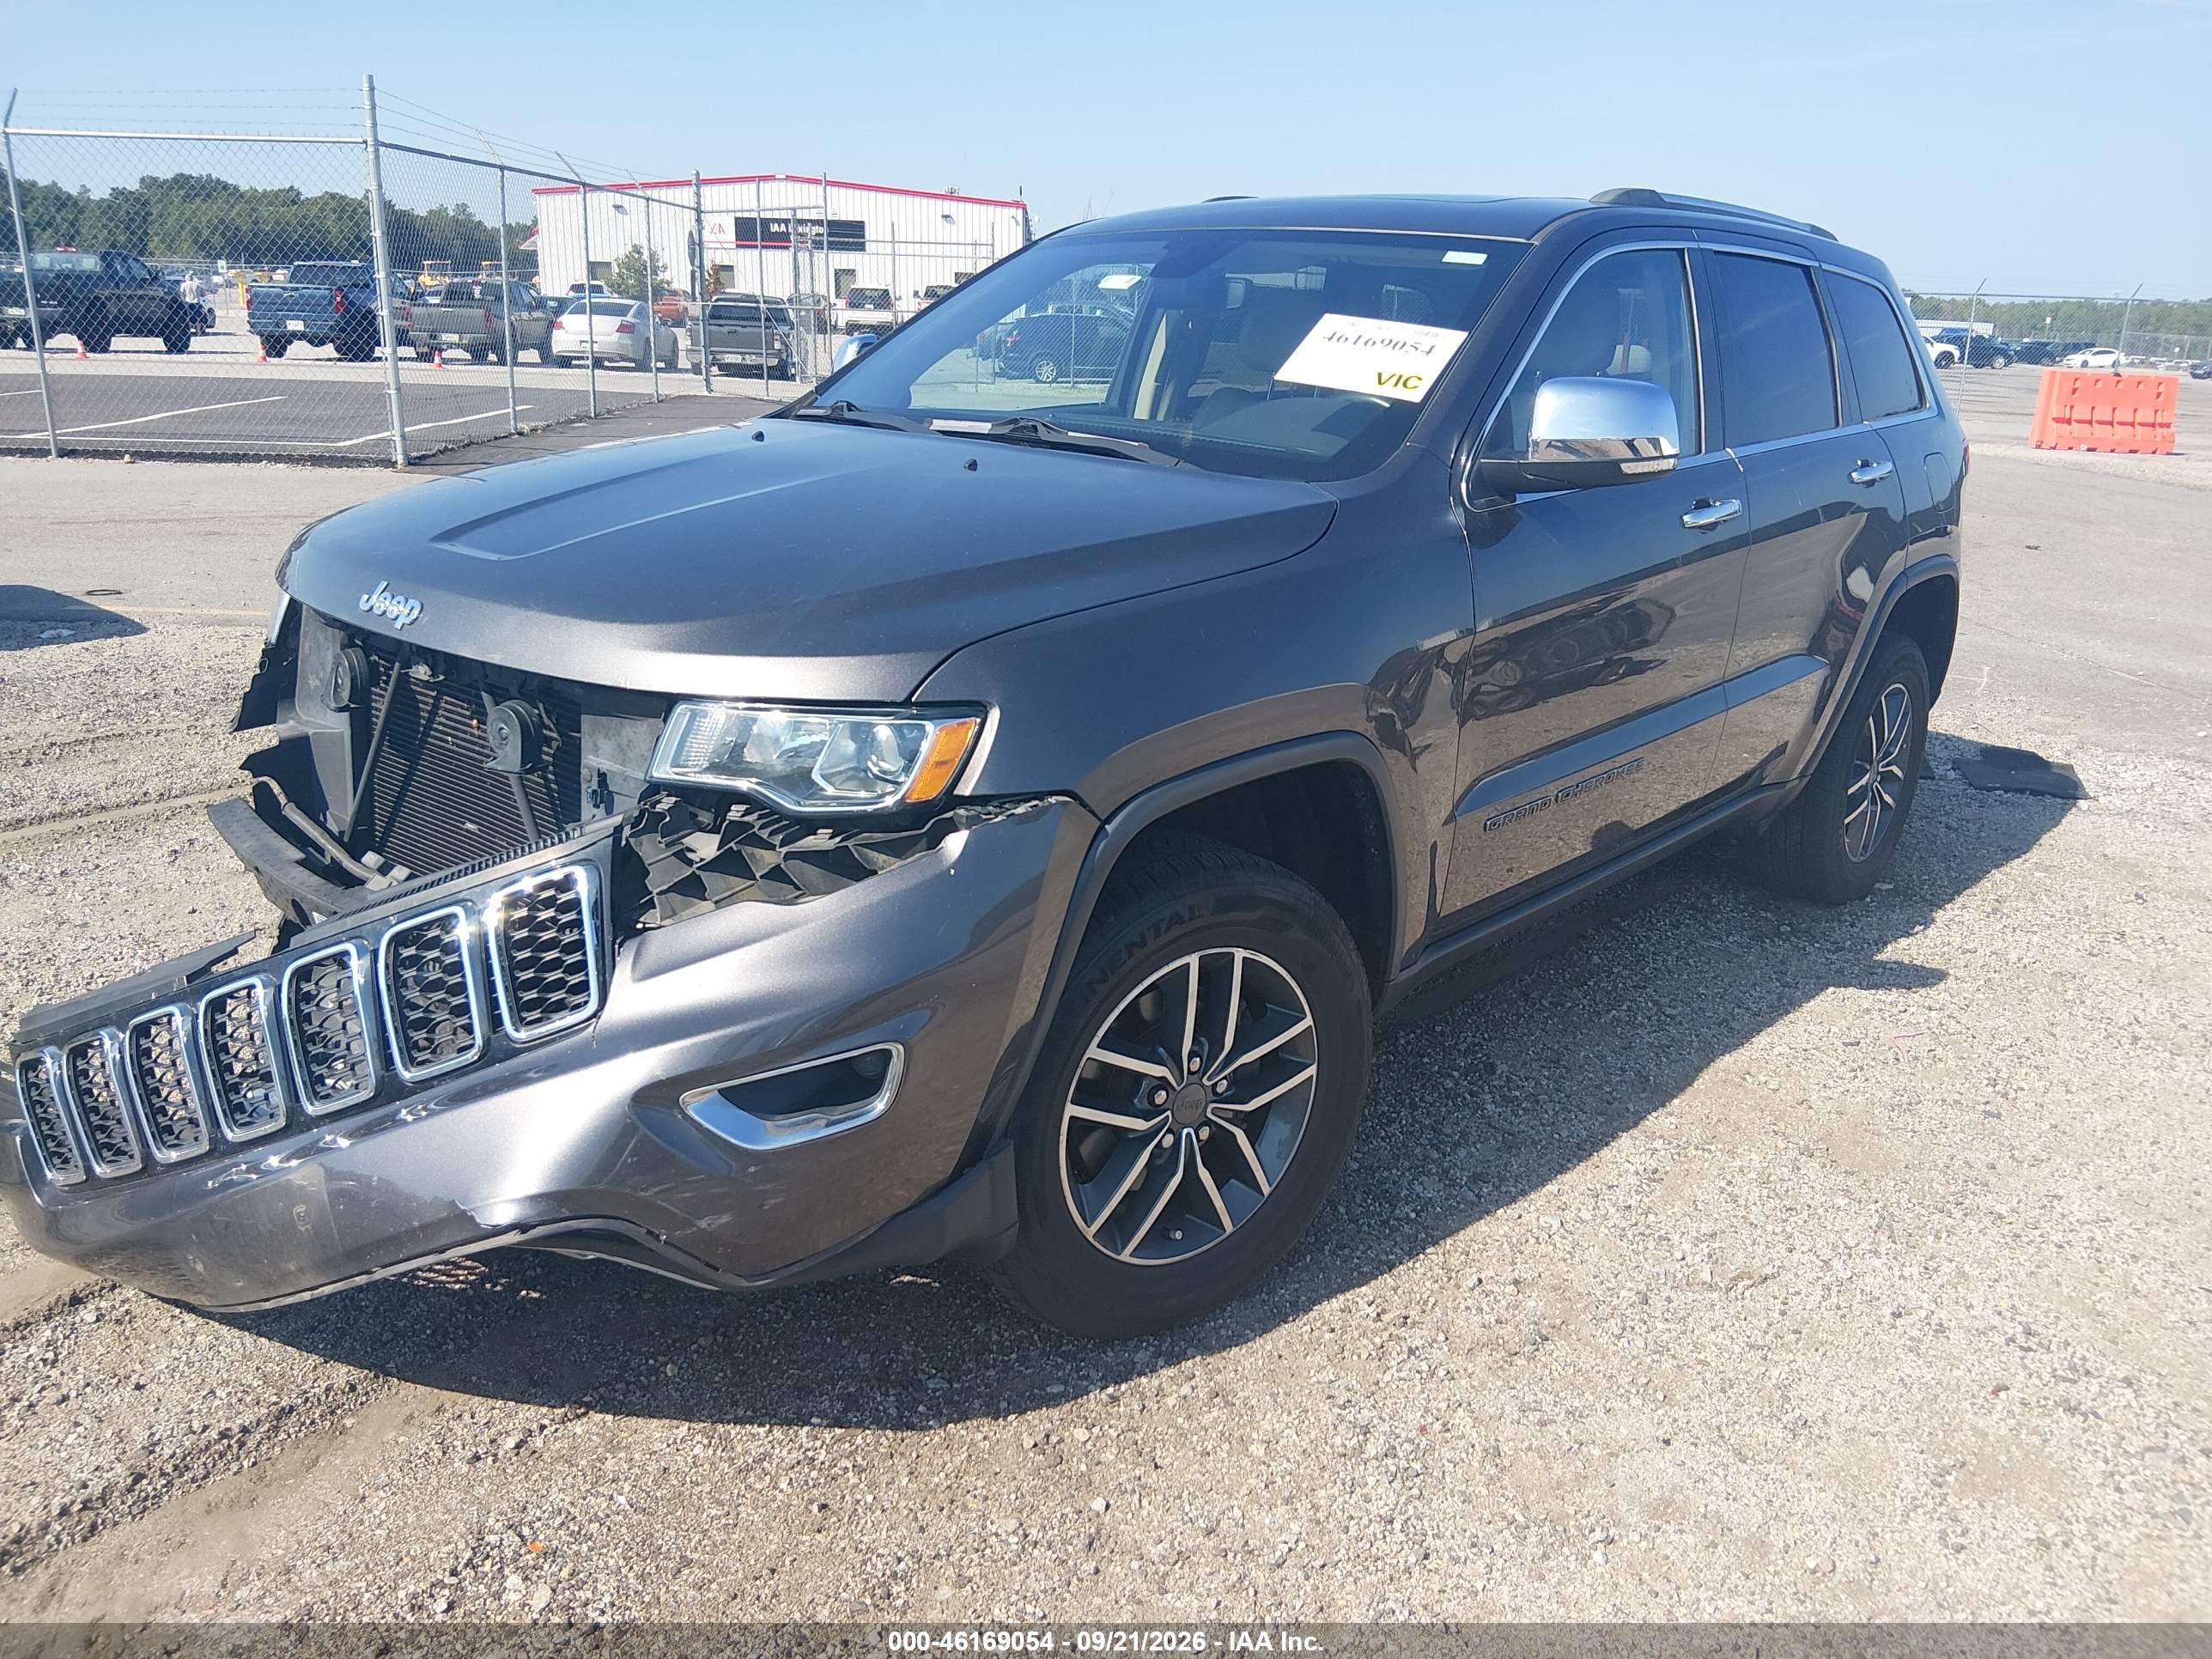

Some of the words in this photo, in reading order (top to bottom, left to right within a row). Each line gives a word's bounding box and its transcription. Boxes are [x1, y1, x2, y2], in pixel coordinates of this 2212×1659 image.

[770, 222, 787, 233] IAA
[788, 222, 829, 236] Lxingto
[1322, 330, 1436, 356] 46169054
[1376, 372, 1423, 390] VIC
[359, 580, 423, 631] Jeep
[1485, 795, 1553, 832] GRAND
[1555, 757, 1644, 805] CHEROKEE
[1176, 1097, 1203, 1113] Jeep
